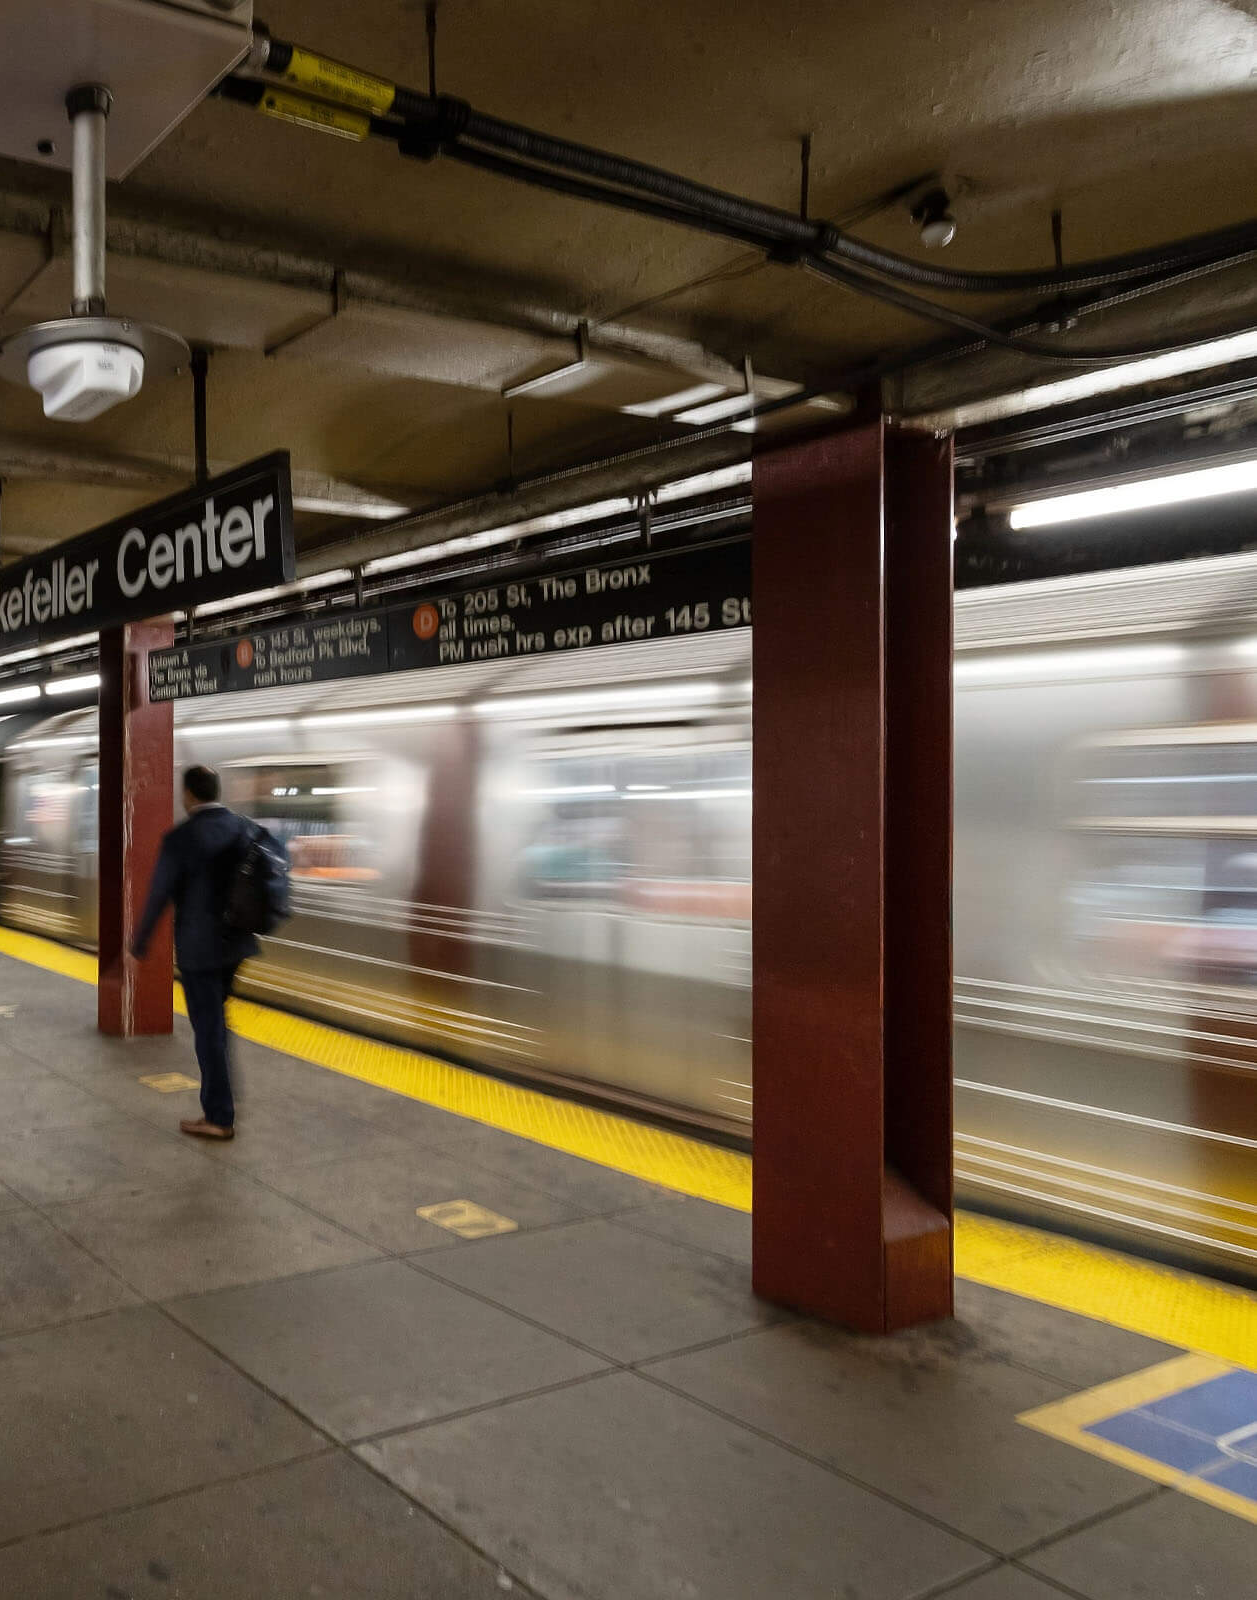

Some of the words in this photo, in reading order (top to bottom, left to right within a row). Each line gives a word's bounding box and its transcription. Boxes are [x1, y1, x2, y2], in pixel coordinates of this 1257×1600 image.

[117, 493, 274, 598] Center
[439, 598, 457, 618] To
[464, 588, 499, 616] 205
[539, 576, 577, 602] The
[585, 563, 652, 595] Bronx
[420, 610, 433, 633] D
[439, 619, 457, 641] all
[439, 638, 465, 663] PM
[471, 632, 509, 659] rush
[553, 624, 592, 648] exp
[601, 613, 656, 642] after
[664, 601, 711, 634] 145
